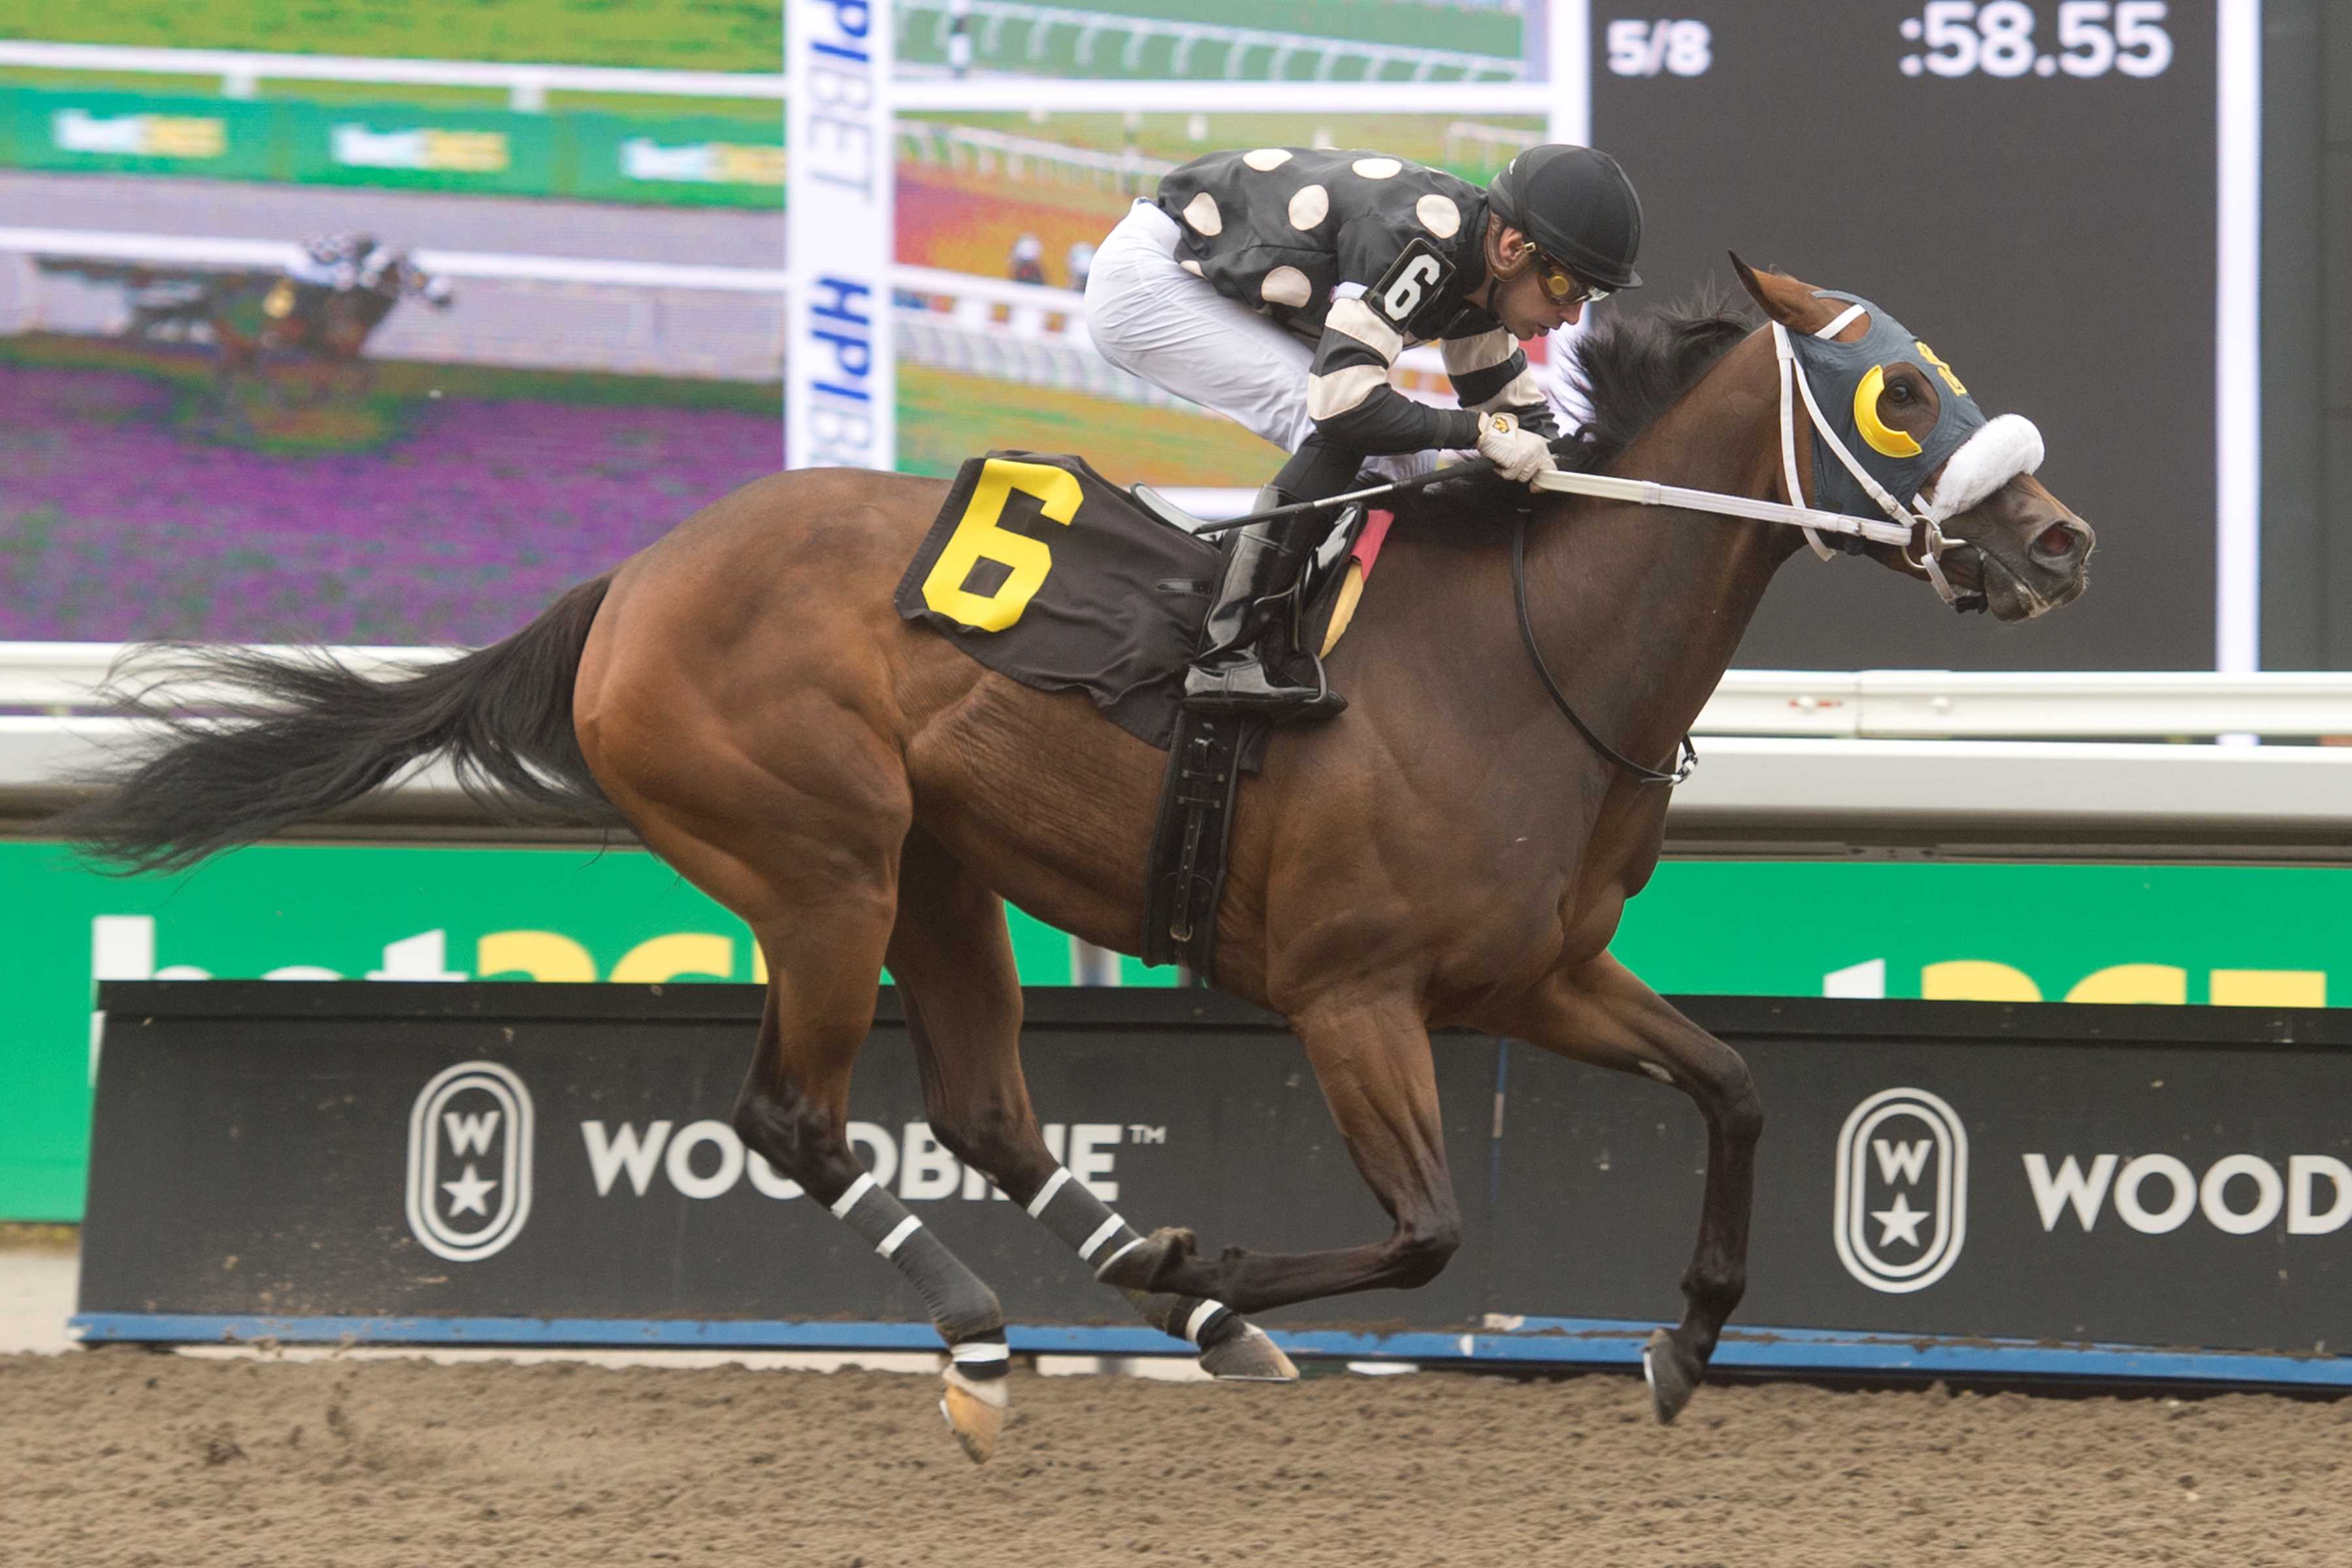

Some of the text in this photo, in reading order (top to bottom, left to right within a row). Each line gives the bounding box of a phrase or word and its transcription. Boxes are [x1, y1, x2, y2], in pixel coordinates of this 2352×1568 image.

[1607, 0, 2173, 77] 5/8 :58.55
[1383, 254, 1441, 321] 6
[921, 459, 1084, 632] 6
[444, 1111, 500, 1157] W
[1872, 1139, 1933, 1186] W
[2022, 1153, 2352, 1235] WOOD
